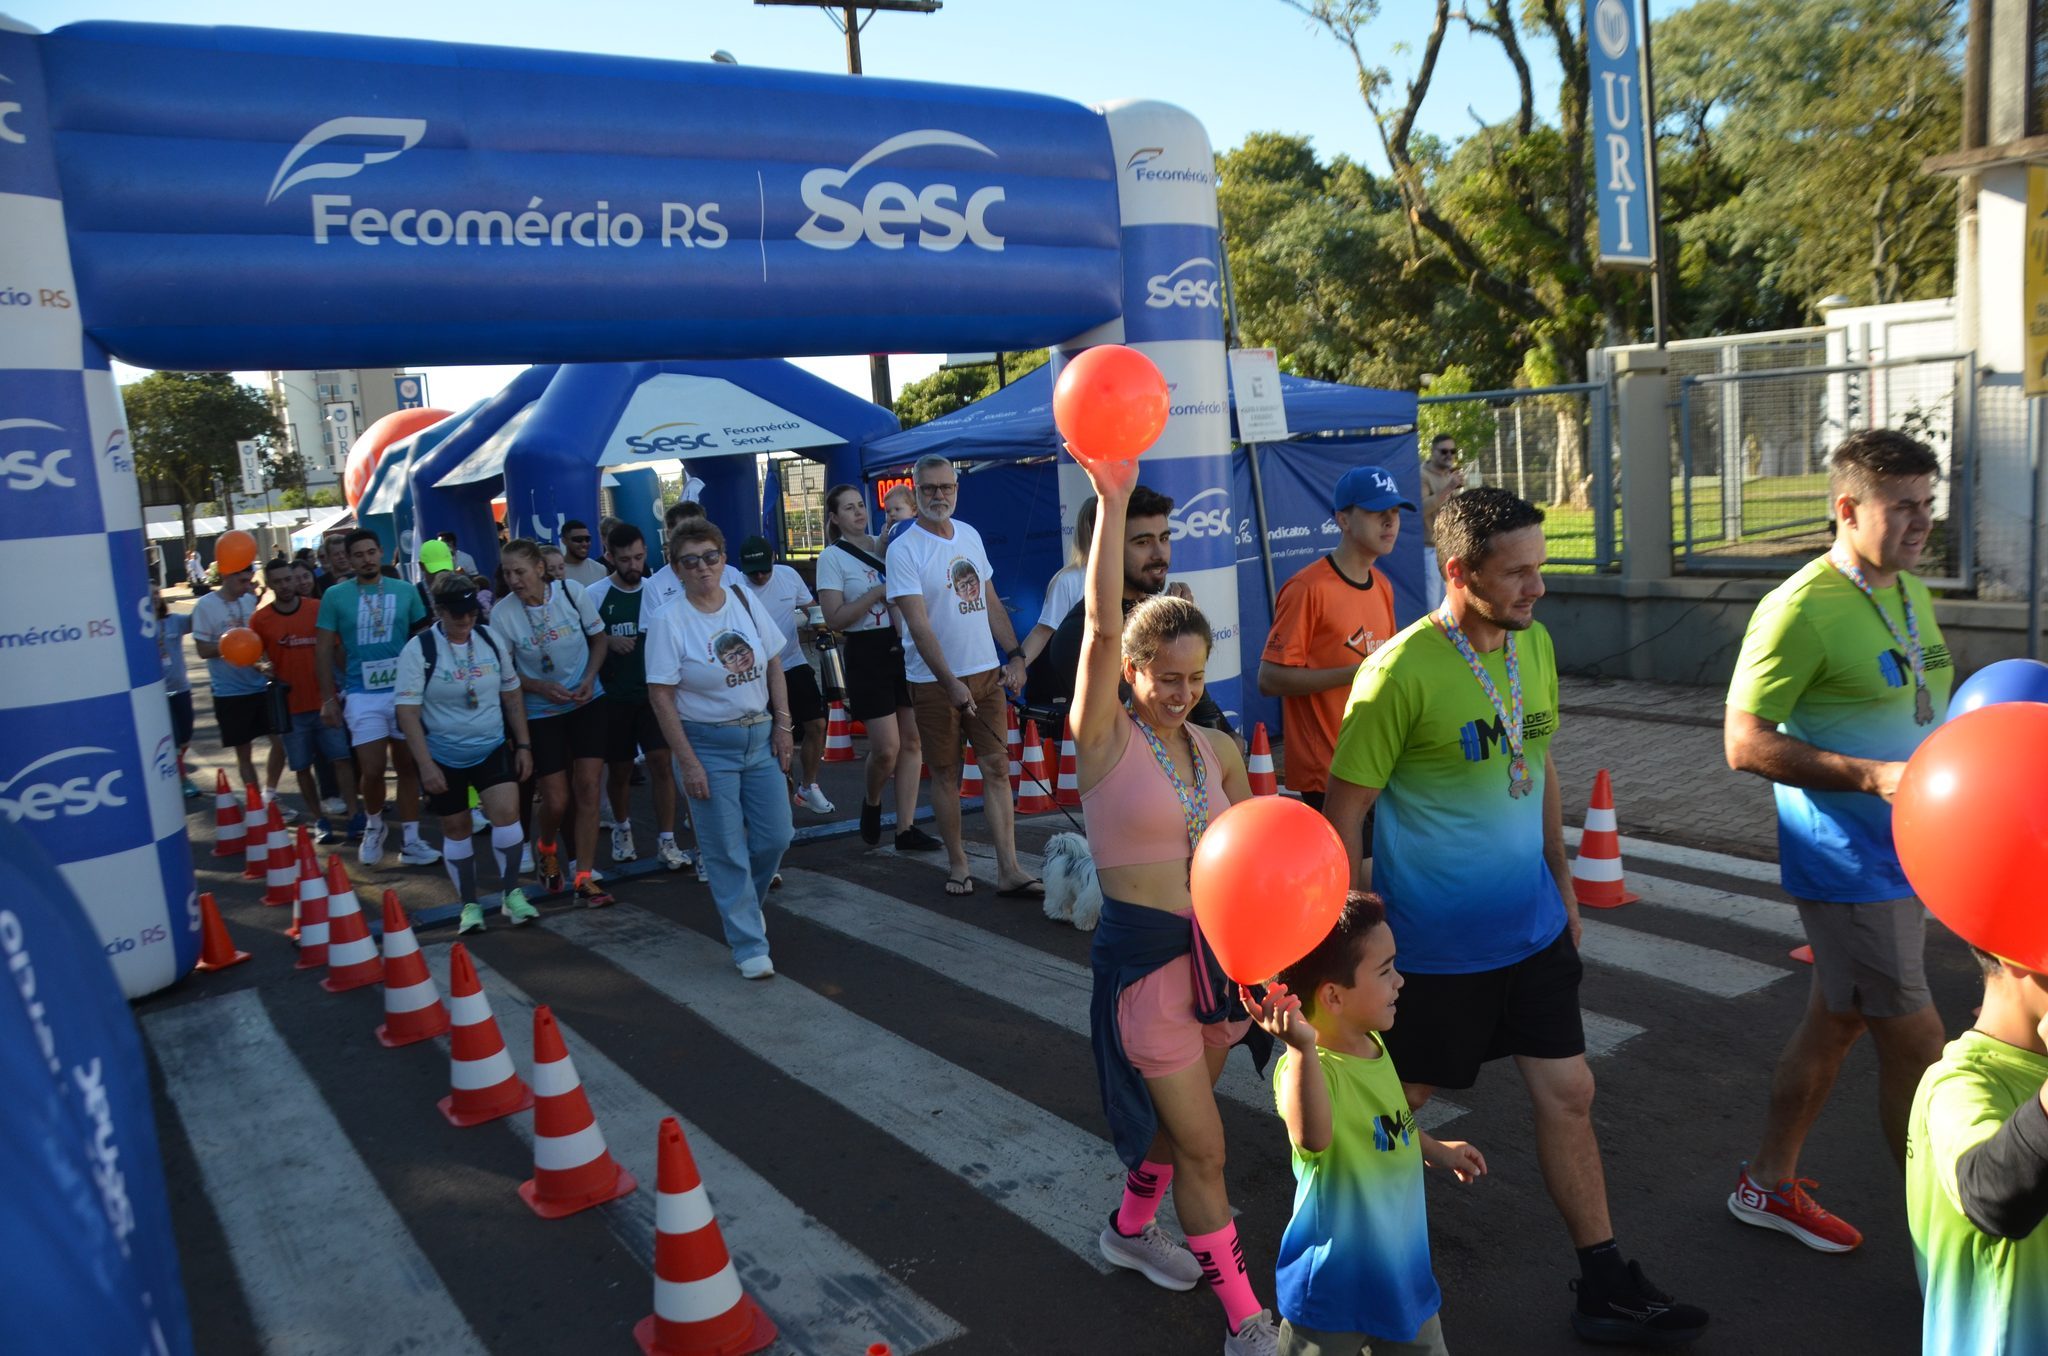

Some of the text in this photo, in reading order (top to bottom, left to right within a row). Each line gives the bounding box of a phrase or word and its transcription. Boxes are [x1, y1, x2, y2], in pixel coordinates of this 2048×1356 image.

[1601, 71, 1636, 252] URI
[795, 166, 1006, 253] Sesc
[311, 195, 729, 249] Fecomércio RS
[39, 288, 71, 308] RS
[1145, 274, 1219, 308] Sesc
[723, 420, 801, 437] Fecomércio
[625, 431, 719, 455] Sesc
[1371, 472, 1399, 494] LA
[958, 597, 986, 615] GAEL
[87, 618, 116, 639] RS
[725, 665, 761, 688] GAEL
[140, 923, 167, 946] RS
